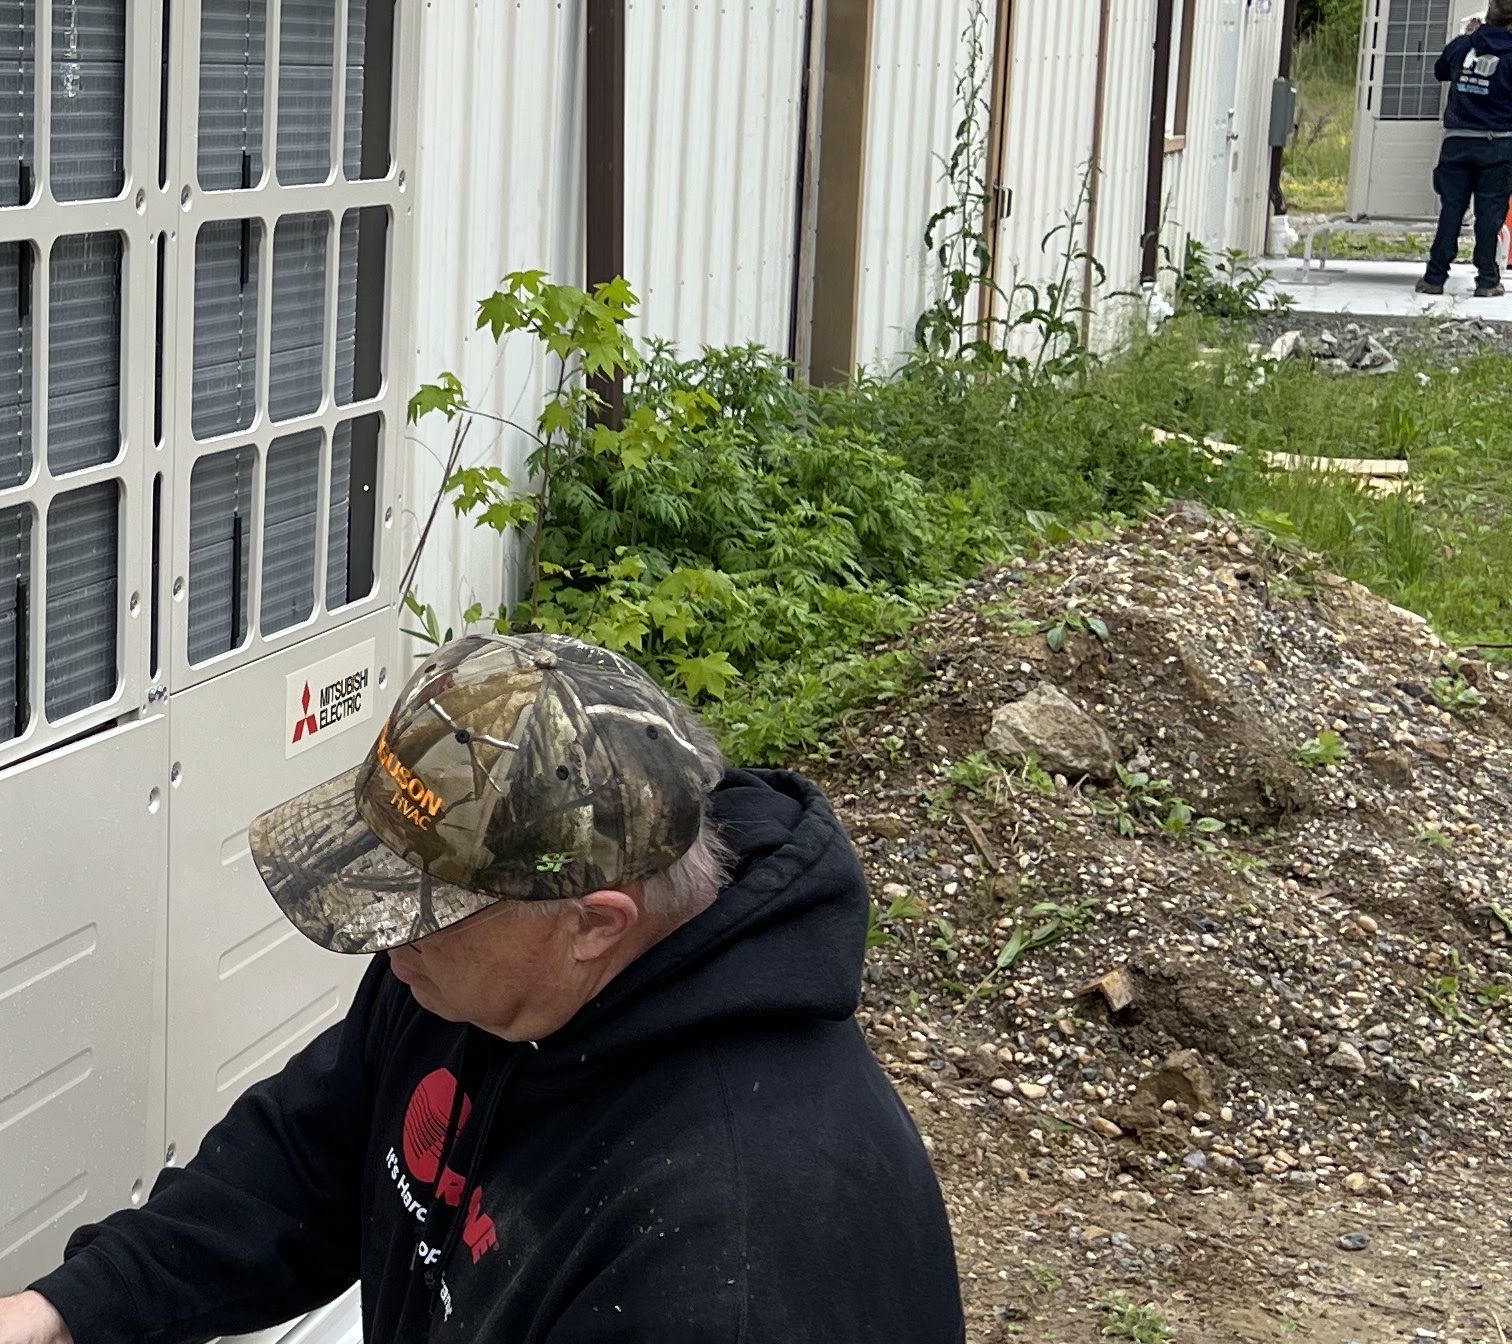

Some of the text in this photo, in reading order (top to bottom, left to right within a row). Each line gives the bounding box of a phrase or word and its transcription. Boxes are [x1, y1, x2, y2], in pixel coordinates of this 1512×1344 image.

[319, 667, 369, 709] MITSUBISHI
[319, 692, 362, 730] ELECTRIC
[390, 792, 432, 831] HVAC
